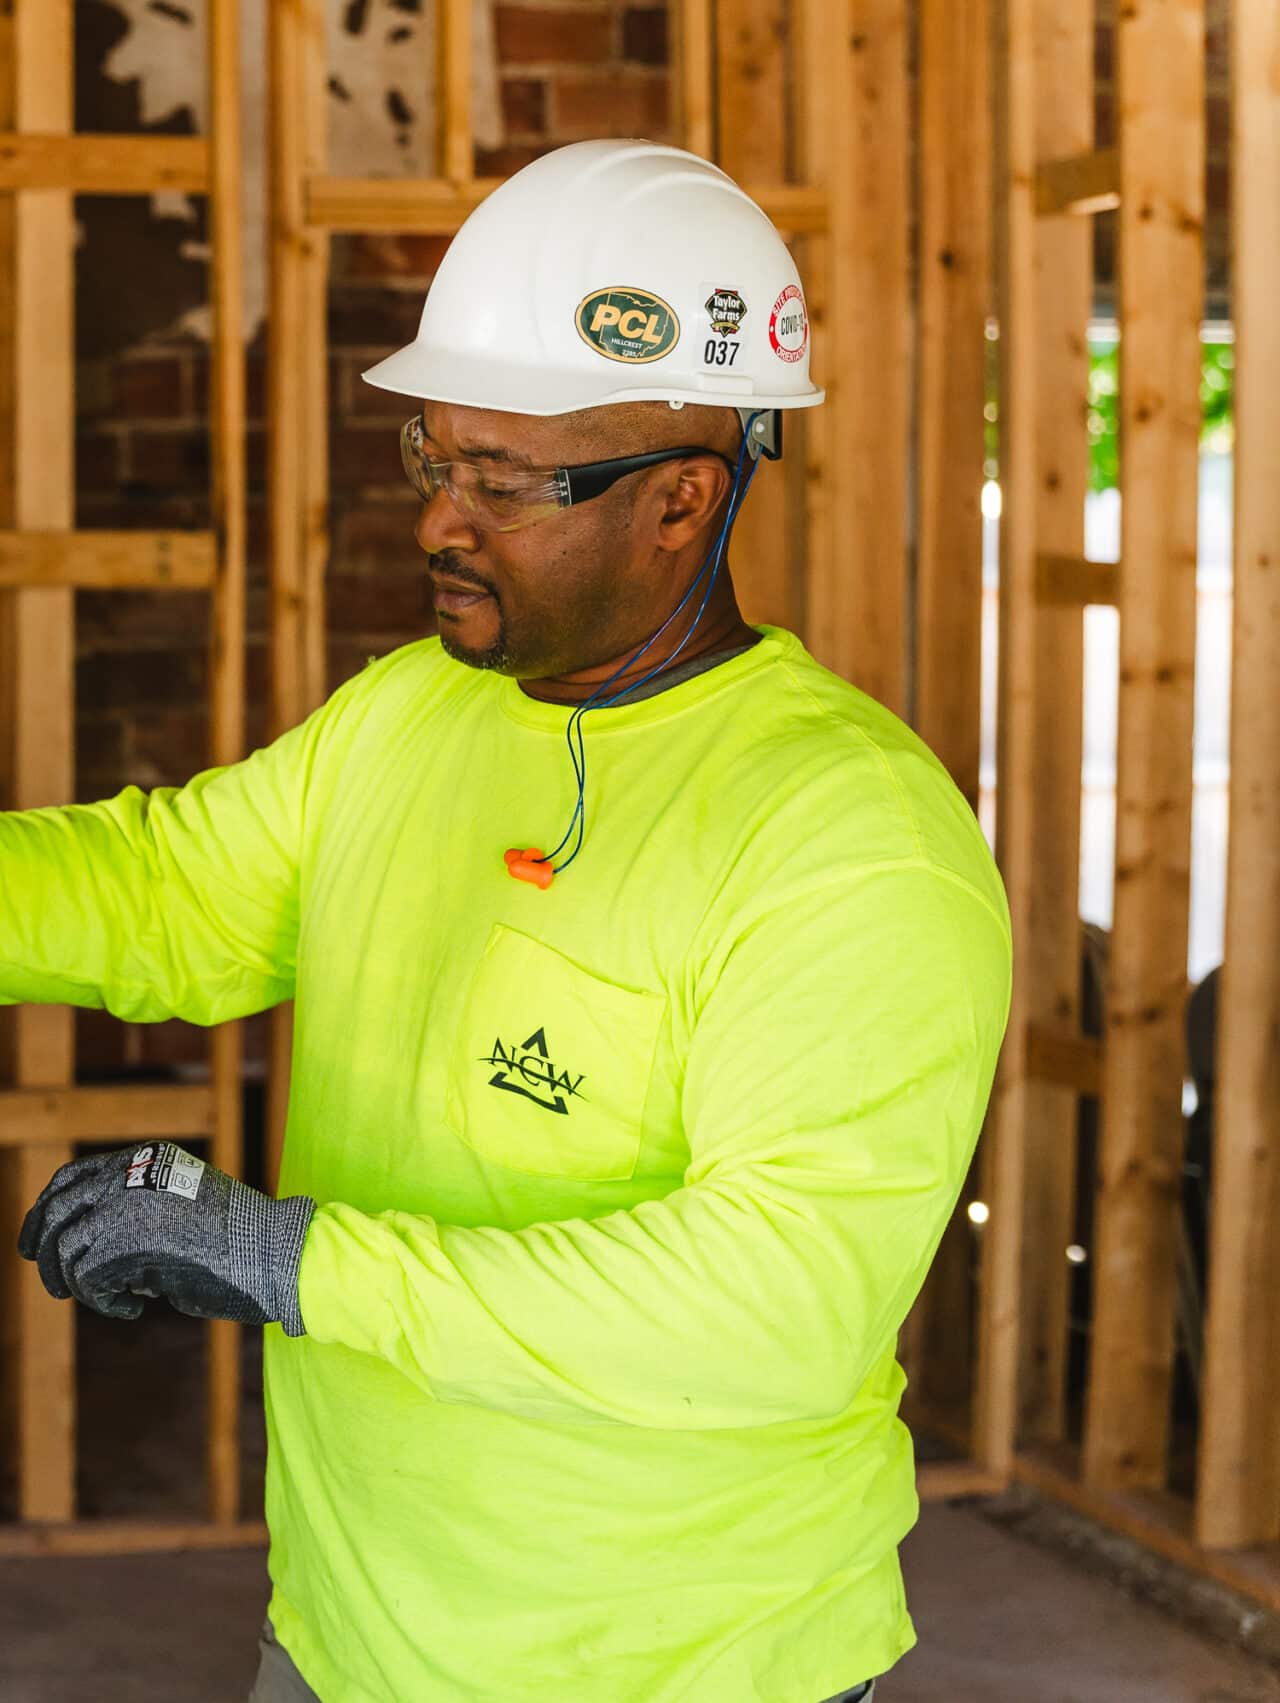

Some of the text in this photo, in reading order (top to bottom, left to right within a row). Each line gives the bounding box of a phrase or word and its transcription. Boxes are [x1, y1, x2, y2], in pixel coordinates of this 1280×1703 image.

[713, 295, 741, 310] Taylor
[590, 303, 663, 345] PCL
[712, 307, 741, 321] Farms
[611, 337, 643, 349] HILLCREST
[704, 339, 740, 366] 037
[488, 1036, 587, 1096] NCW
